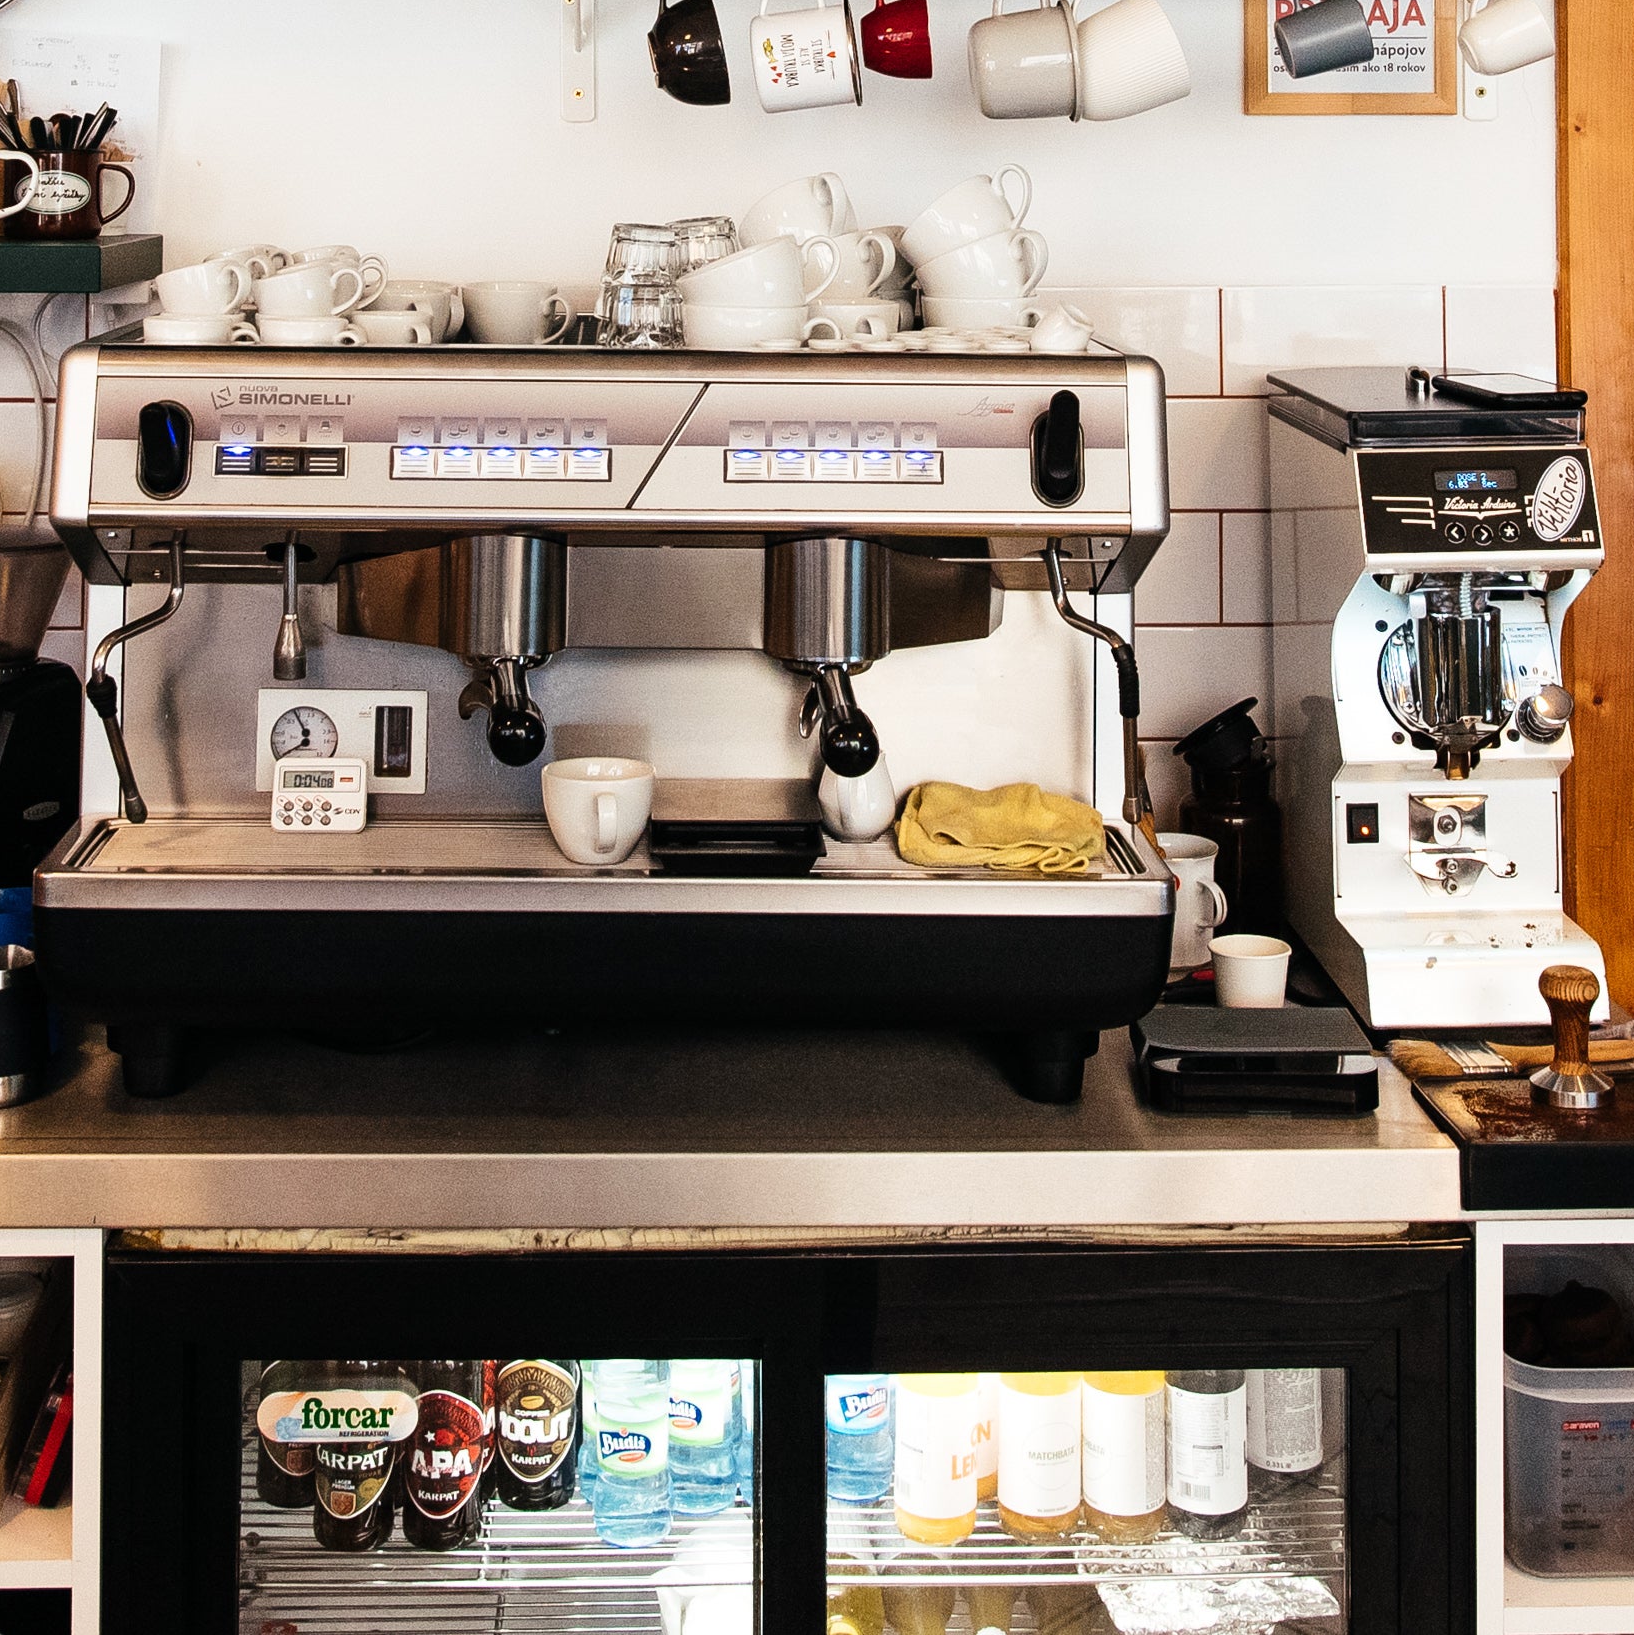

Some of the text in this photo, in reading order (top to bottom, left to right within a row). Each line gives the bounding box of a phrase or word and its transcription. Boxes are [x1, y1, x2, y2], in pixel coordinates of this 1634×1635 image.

[1362, 63, 1426, 73] ako 18 rokov
[239, 385, 279, 393] nuova
[238, 393, 352, 406] SIMONELLI
[1456, 473, 1486, 481] DOSE 2
[1481, 479, 1498, 489] Sec
[1444, 496, 1517, 511] Victoria Arduino
[344, 807, 361, 815] CDN
[302, 1398, 396, 1430] forcar
[514, 1409, 551, 1417] COFFEE
[338, 1430, 390, 1438] REFRIGERATION
[601, 1431, 647, 1455] Budiš
[511, 1452, 552, 1466] KARPAT
[1028, 1445, 1076, 1462] MATCHBATA
[412, 1449, 474, 1480] APA
[418, 1489, 460, 1503] KARPAT
